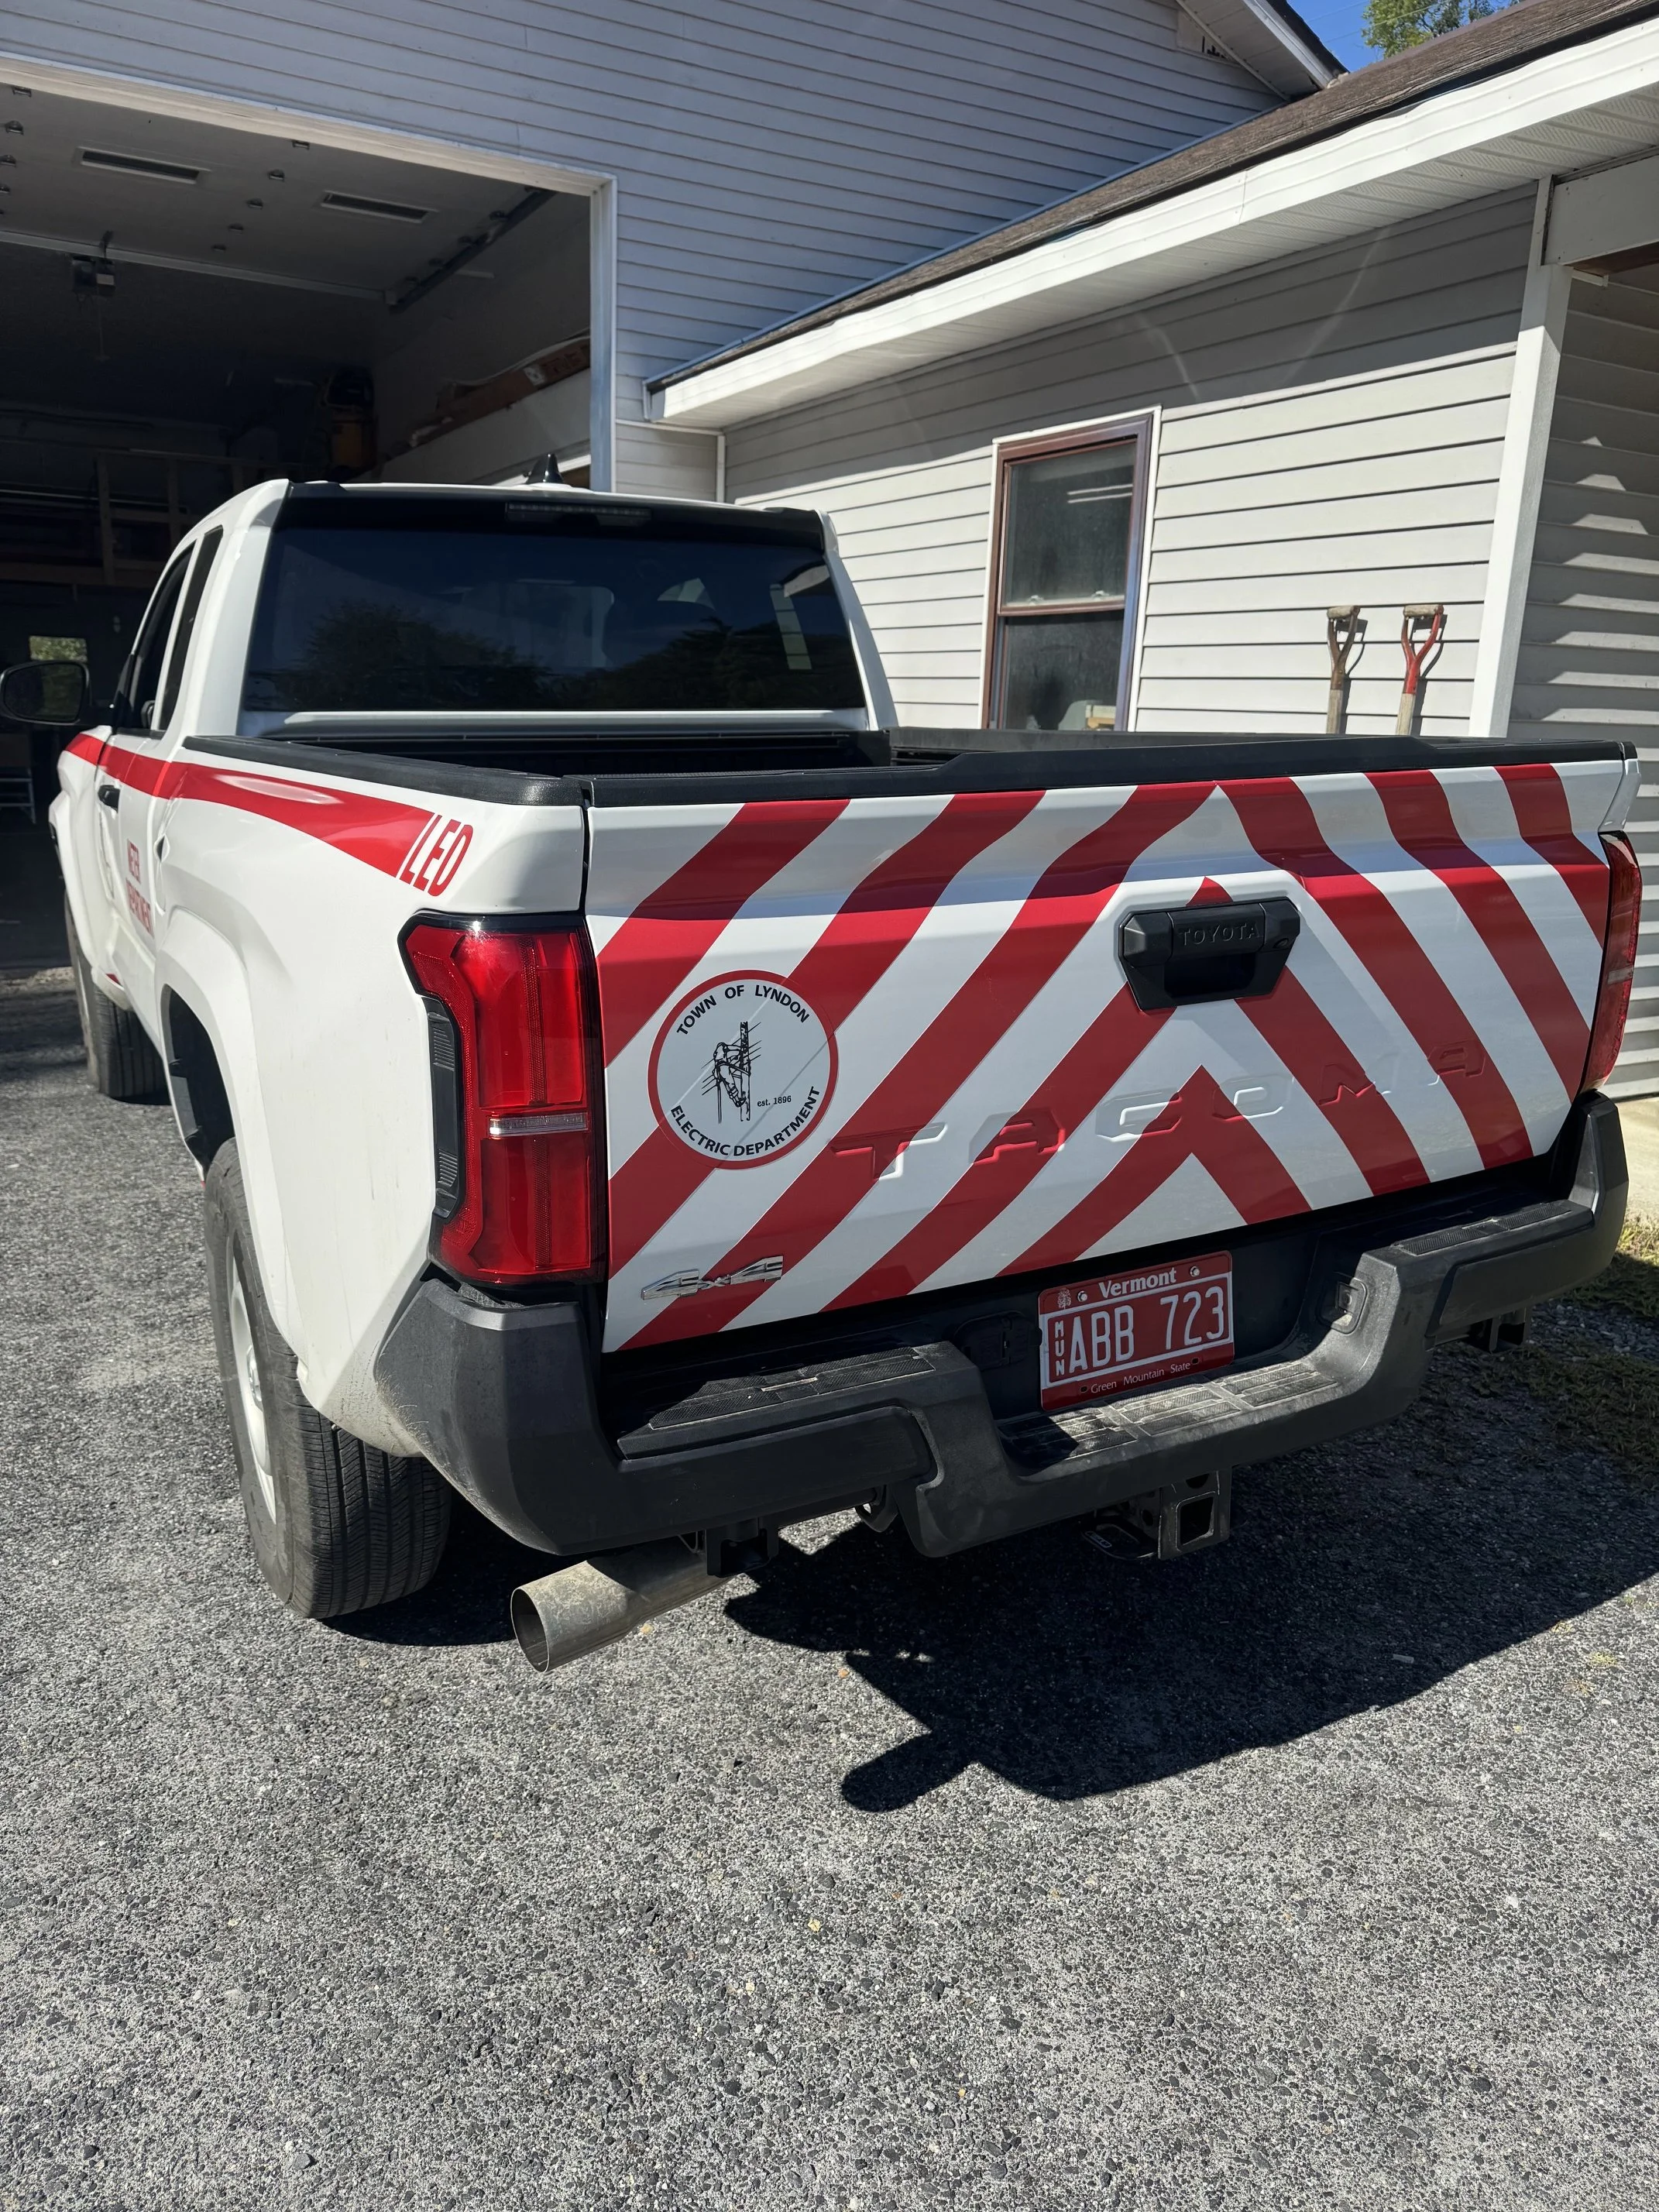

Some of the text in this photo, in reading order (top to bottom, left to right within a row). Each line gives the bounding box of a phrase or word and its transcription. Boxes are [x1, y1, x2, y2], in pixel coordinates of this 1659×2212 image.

[400, 815, 473, 896] LED
[1177, 922, 1261, 946] TOYOTA
[676, 984, 810, 1036] TOWN OF LYNDON
[670, 1086, 820, 1157] ELECTRIC DEPARTMENT
[757, 1095, 792, 1108] est. 1896
[829, 1039, 1486, 1181] TACOMA
[1098, 1266, 1177, 1298] Vermont
[1054, 1320, 1065, 1376] MUN
[1068, 1286, 1224, 1374] ABB 723
[1091, 1362, 1191, 1393] Green Mountain State
